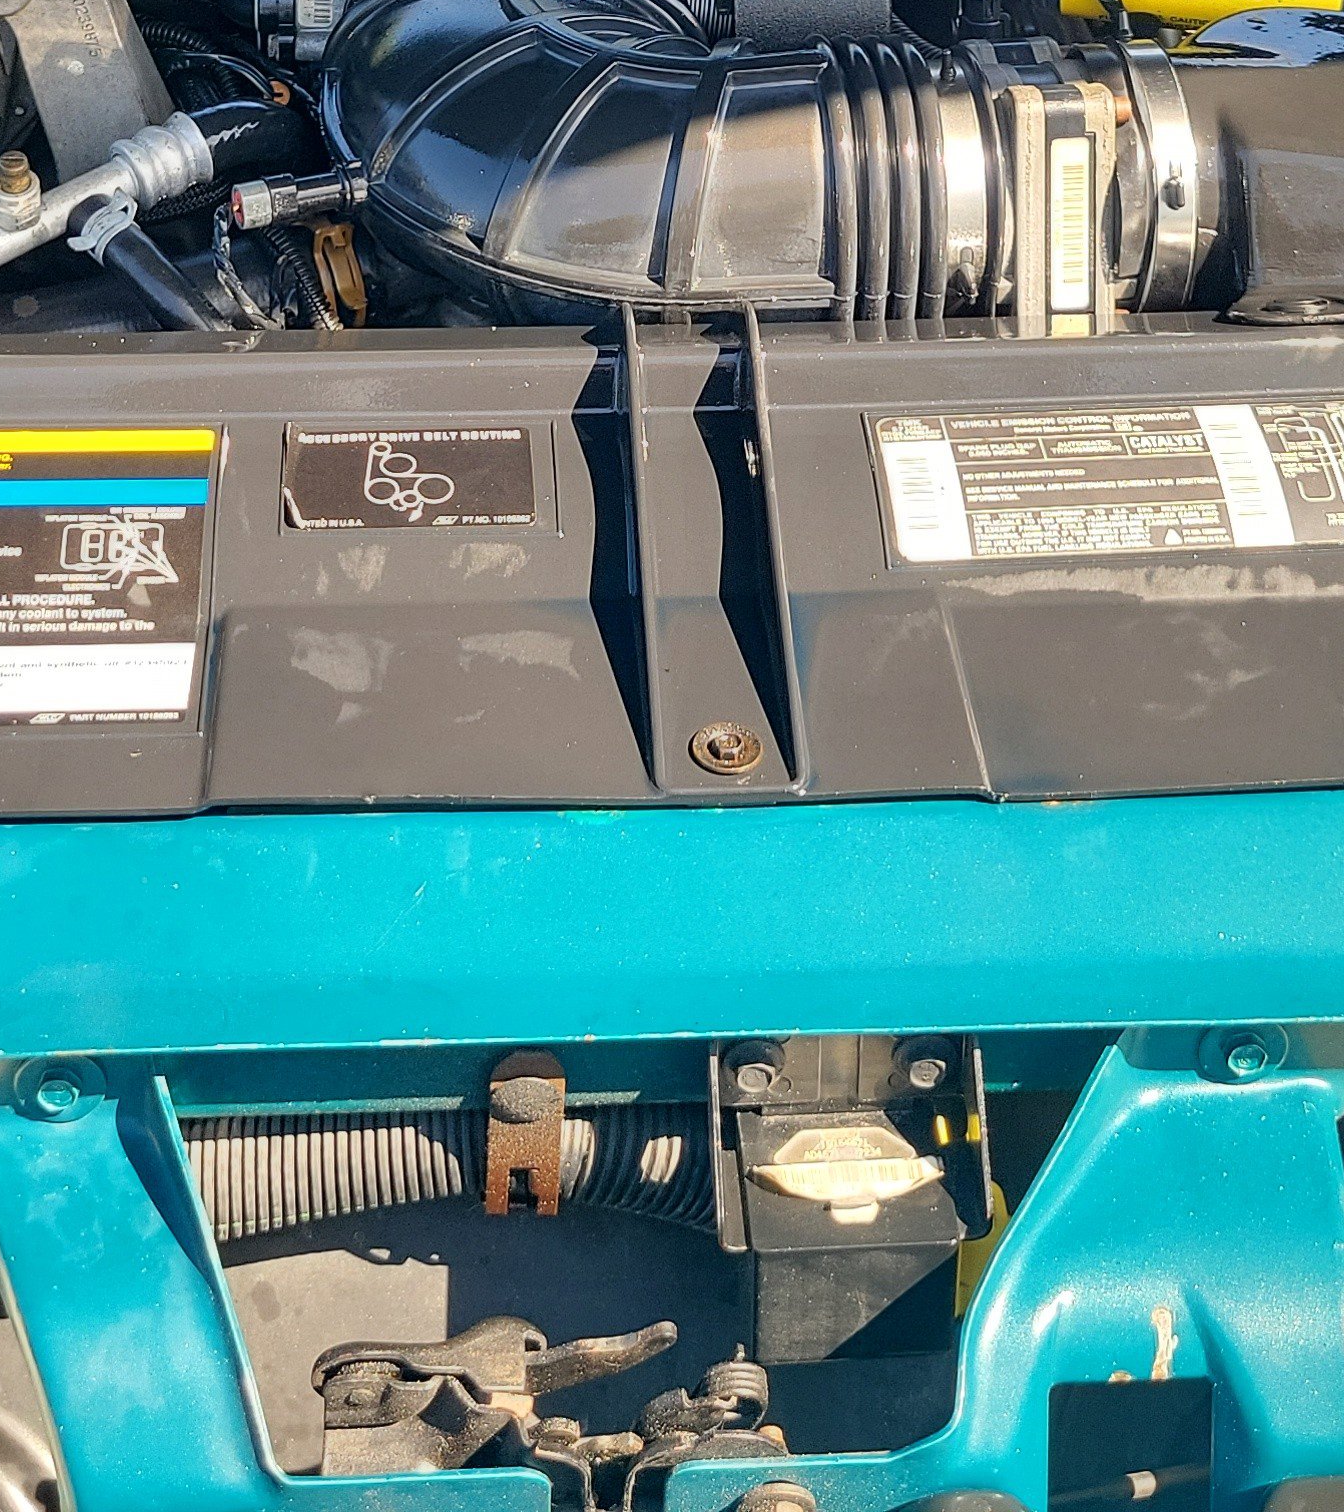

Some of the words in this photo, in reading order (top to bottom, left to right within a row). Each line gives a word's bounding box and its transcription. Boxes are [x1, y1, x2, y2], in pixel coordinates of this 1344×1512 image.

[298, 432, 377, 443] ACCESSORY
[379, 432, 420, 442] DRIVE
[423, 431, 458, 441] BELT
[460, 430, 521, 440] ROUTING
[1129, 433, 1204, 448] CATALYST
[12, 594, 95, 606] PROCEDURE.
[18, 608, 64, 618] coolant
[65, 608, 80, 618] to
[81, 608, 127, 619] system.
[8, 621, 21, 632] in
[22, 620, 67, 631] serious
[68, 620, 117, 632] damage
[119, 620, 134, 630] to
[135, 619, 156, 630] the
